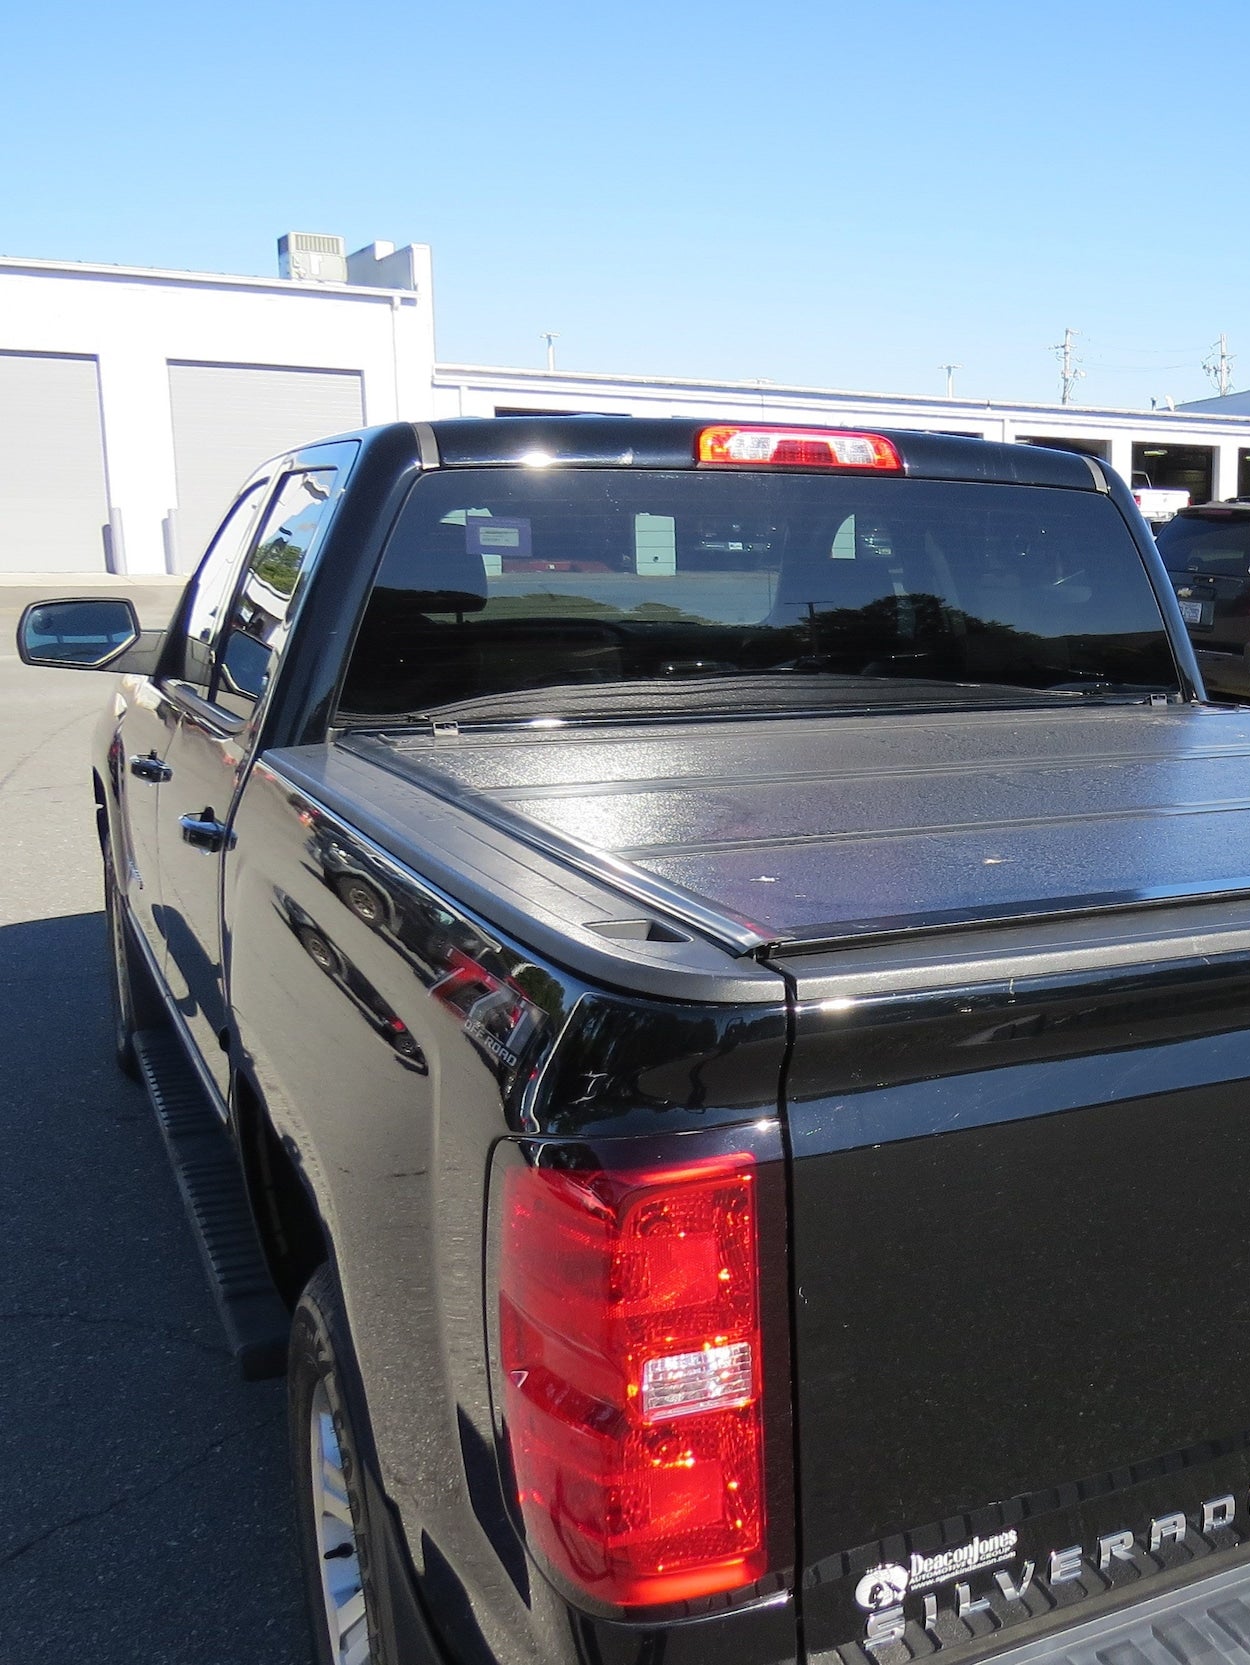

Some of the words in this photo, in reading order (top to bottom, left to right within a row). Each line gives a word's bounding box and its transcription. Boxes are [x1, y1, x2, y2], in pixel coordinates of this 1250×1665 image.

[464, 1019, 486, 1038] OFF
[484, 1037, 518, 1067] ROAD
[908, 1560, 967, 1586] AUTOMOTIVE
[979, 1546, 1012, 1561] GROUP
